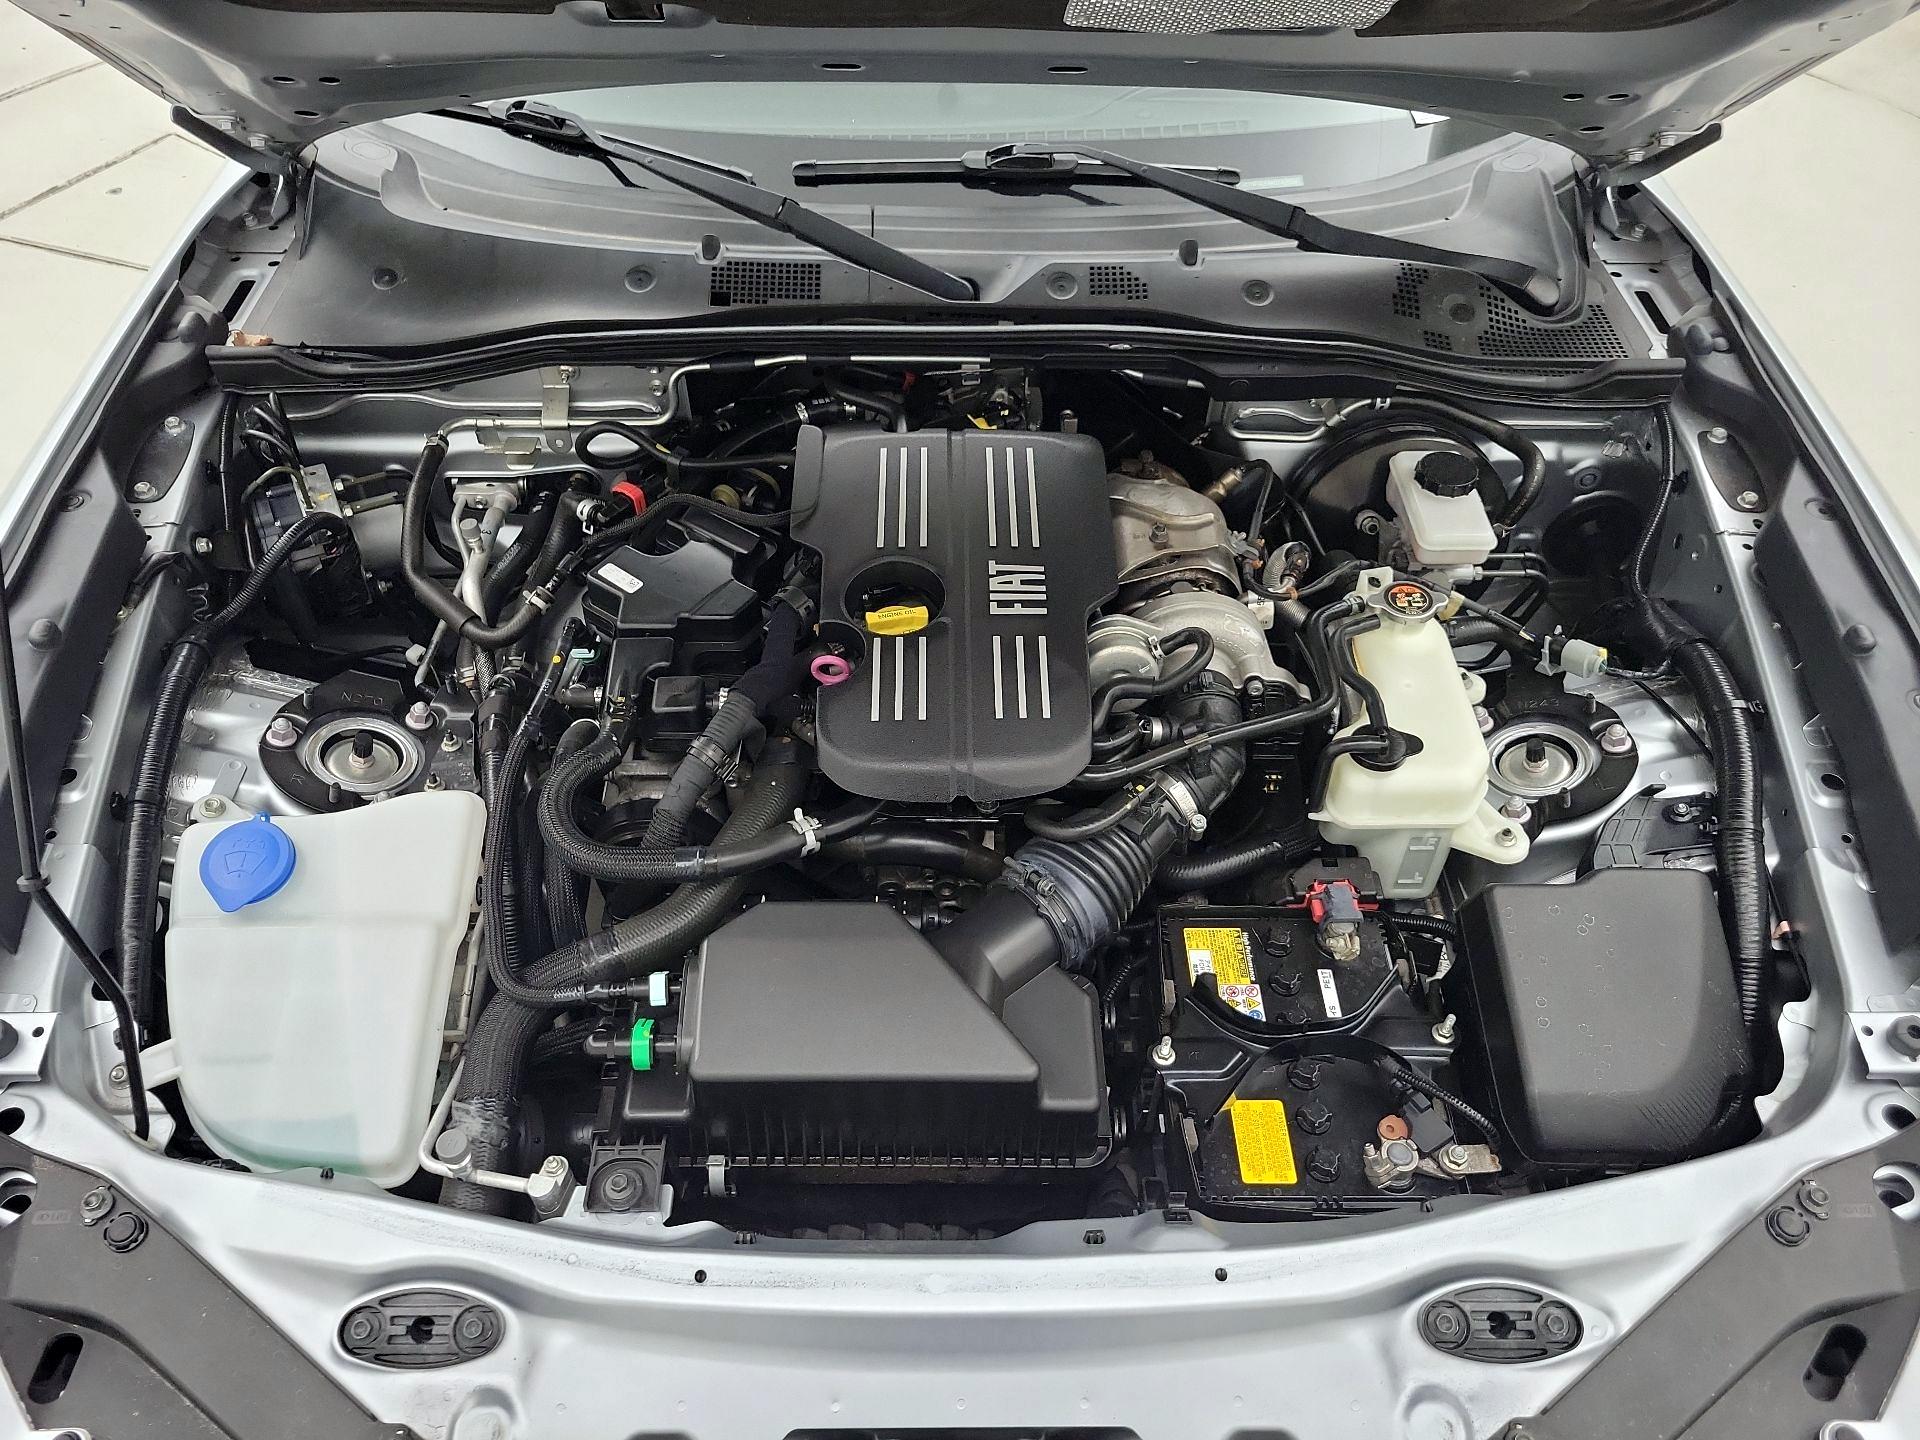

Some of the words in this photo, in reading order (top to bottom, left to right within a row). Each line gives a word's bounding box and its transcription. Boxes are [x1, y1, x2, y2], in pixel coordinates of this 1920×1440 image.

[989, 560, 1048, 615] FIAT
[877, 612, 903, 620] ENGINE
[1241, 932, 1250, 945] High
[1244, 945, 1255, 981] Performance
